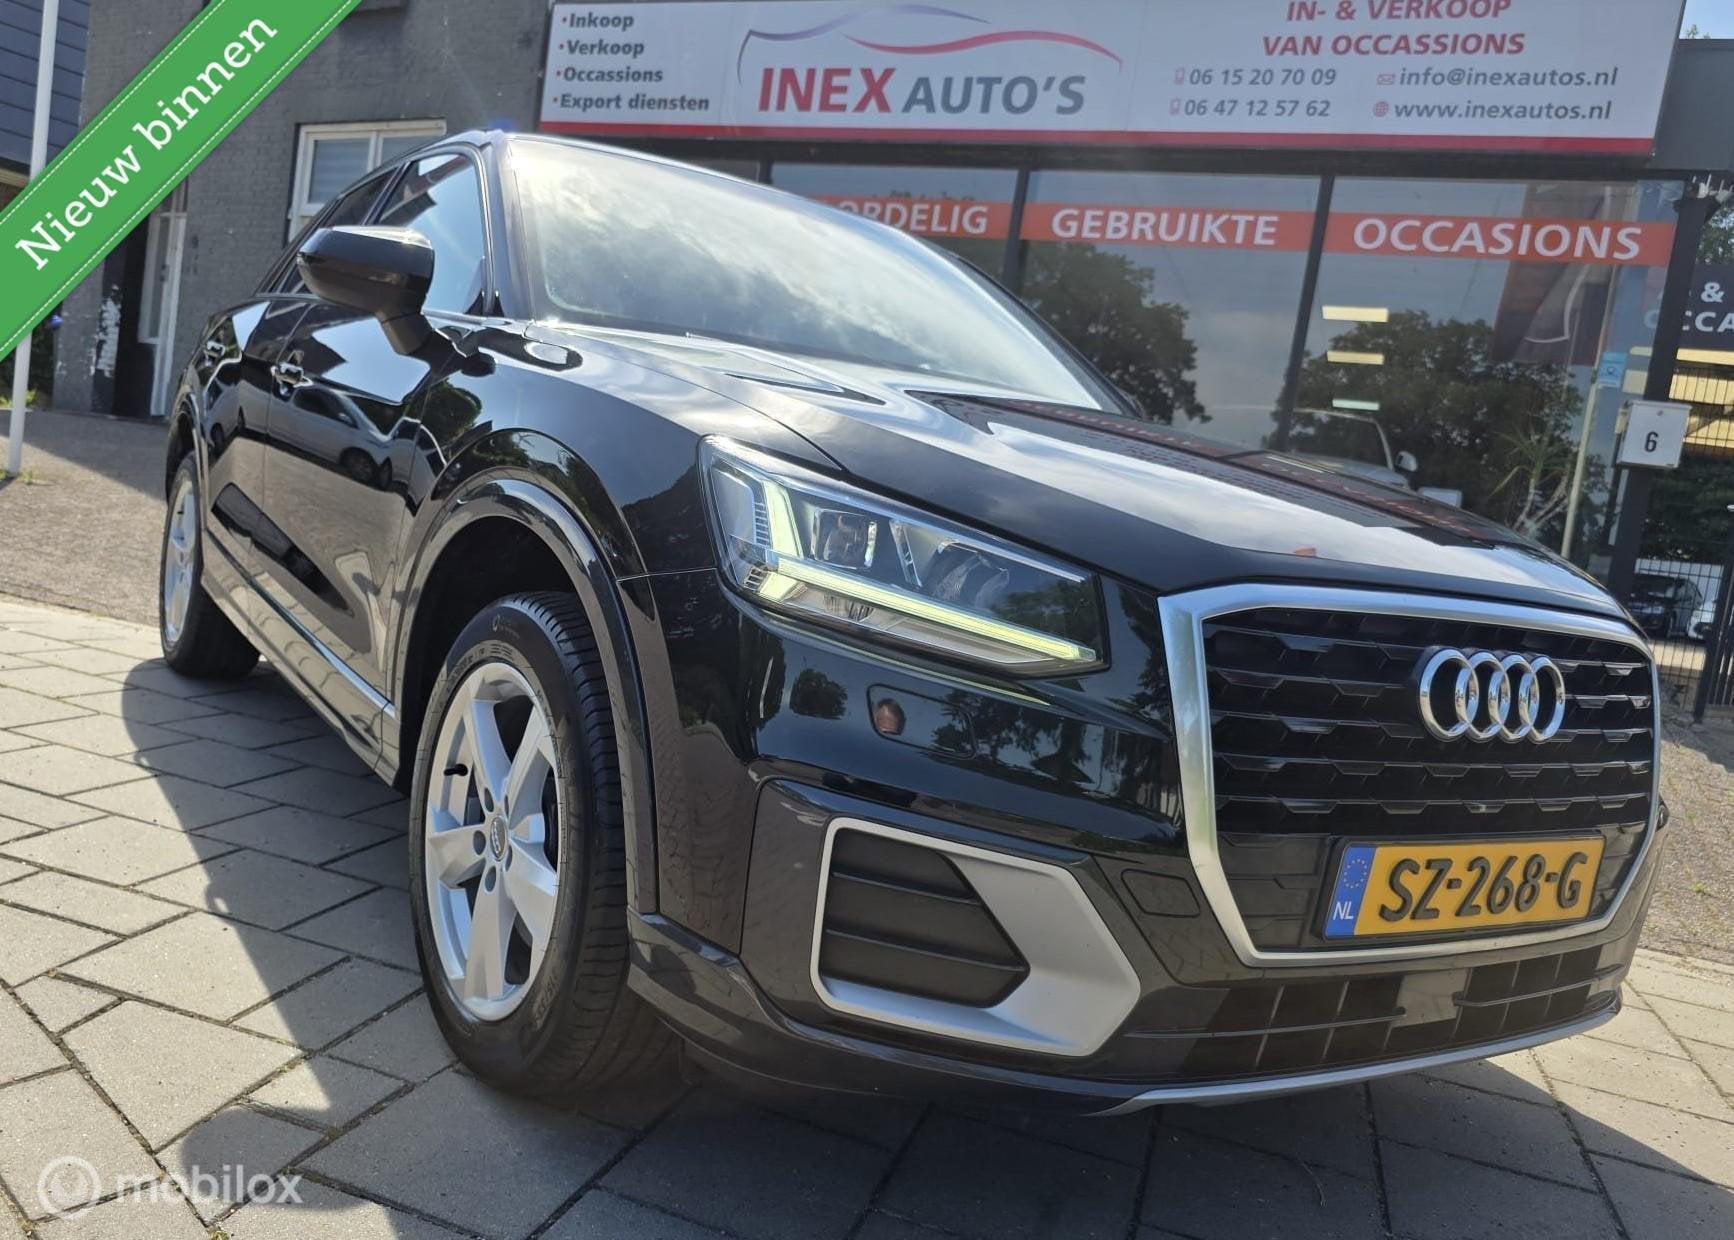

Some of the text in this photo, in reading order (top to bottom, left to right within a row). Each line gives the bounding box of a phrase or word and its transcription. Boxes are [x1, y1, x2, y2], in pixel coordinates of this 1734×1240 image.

[1286, 0, 1512, 21] IN- & VERKOOP
[569, 12, 634, 31] Inkoop
[567, 39, 644, 58] Verkoop
[1263, 33, 1525, 56] VAN OCCASSIONS
[563, 66, 663, 82] Occassions
[1189, 69, 1336, 85] 06 15 20 70 09
[1400, 67, 1618, 86] info@inexautos.nl
[758, 67, 1086, 115] INEX AUTO'S
[560, 94, 710, 112] Export diensten
[1184, 99, 1331, 117] 06 47 12 57 62
[1395, 101, 1611, 119] www.inexautos.nl
[1052, 209, 1280, 245] GEBRUIKTE
[1354, 218, 1642, 260] OCCASIONS
[1701, 282, 1725, 303] &
[1644, 432, 1659, 452] 6
[1379, 852, 1588, 922] SZ-268-G
[1333, 901, 1354, 920] NL
